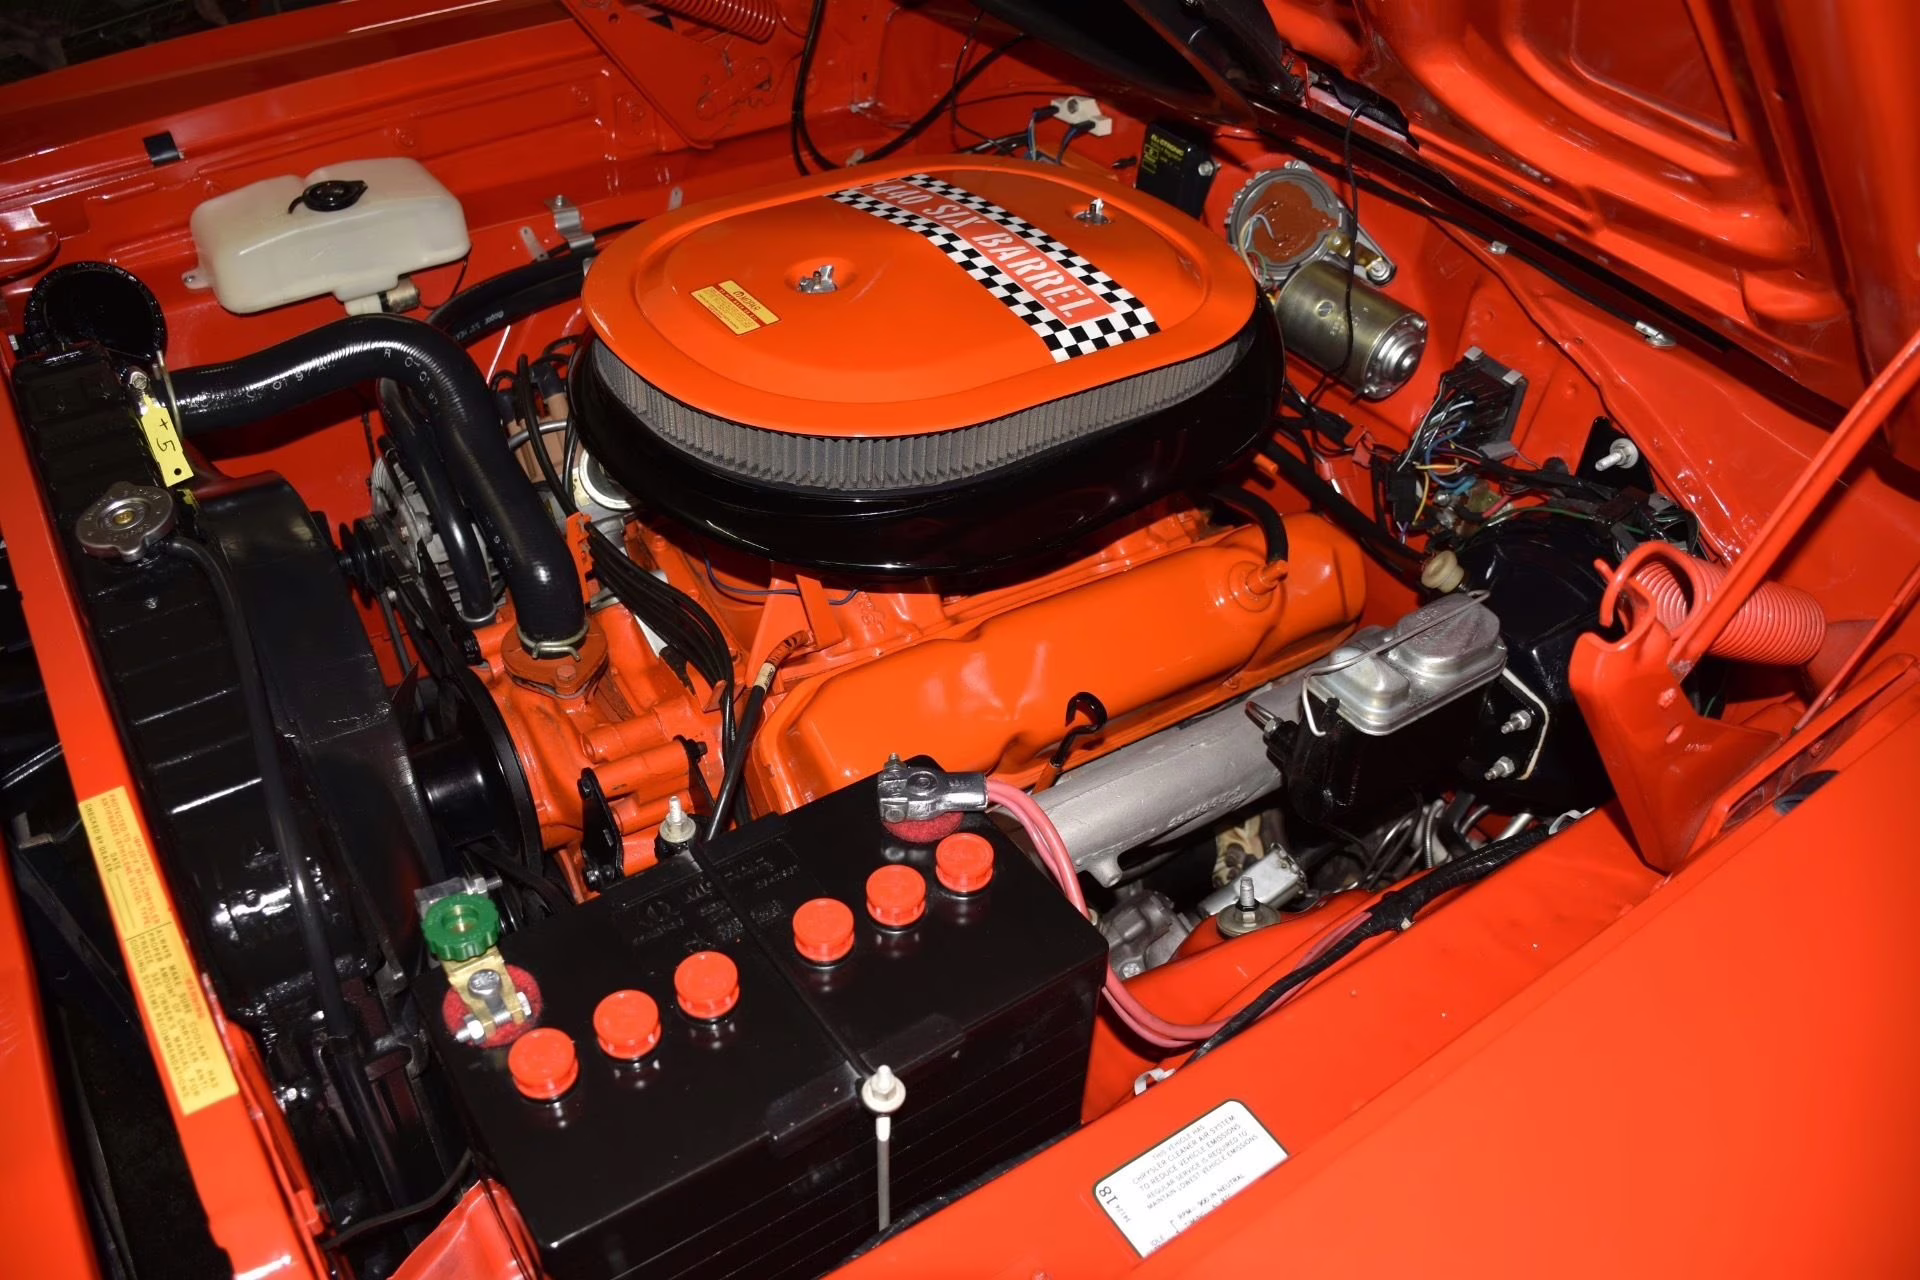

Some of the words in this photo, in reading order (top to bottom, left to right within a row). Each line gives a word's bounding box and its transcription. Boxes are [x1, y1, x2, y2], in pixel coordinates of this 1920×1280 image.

[871, 184, 934, 205] 440
[921, 203, 988, 229] SIX
[971, 233, 1096, 318] BARREL
[84, 803, 100, 834] CHECKED
[99, 846, 112, 872] DEALER
[109, 794, 127, 831] PROTECTED
[110, 852, 121, 869] DATE
[129, 939, 146, 973] COOLING
[147, 932, 163, 962] PROPER
[159, 966, 175, 998] AMOUNT
[171, 1002, 181, 1013] OF
[177, 1018, 198, 1063] CHRYSLER
[155, 928, 171, 958] ALWAYS
[169, 964, 182, 986] MAKE
[178, 992, 192, 1013] SURE
[189, 1021, 208, 1061] COOLANT
[206, 1069, 218, 1088] HAS
[185, 978, 205, 1019] WARNING
[151, 971, 161, 986] SEE
[173, 1035, 190, 1069] MANUAL
[188, 1077, 199, 1096] FOR
[1131, 1159, 1166, 1184] CHRYSLER
[1167, 1139, 1197, 1161] CLEANER
[1198, 1131, 1209, 1141] AIR
[1209, 1114, 1235, 1134] SYSTEM
[1139, 1182, 1150, 1191] TO
[1150, 1164, 1177, 1184] REDUCE
[1179, 1146, 1205, 1166] VEHICLE
[1206, 1123, 1240, 1148] EMISSIONS
[1146, 1178, 1175, 1199] REGULAR
[1175, 1162, 1200, 1181] SERVICE
[1207, 1136, 1238, 1159] REQUIRED
[1238, 1130, 1247, 1138] TO
[1146, 1187, 1176, 1209] MAINTAIN
[1176, 1171, 1201, 1190] LOWEST
[1201, 1155, 1226, 1174] VEHICLE
[1226, 1133, 1258, 1157] EMISSIONS
[1152, 1148, 1166, 1160] THIS
[1167, 1132, 1191, 1150] VEHICLE
[1191, 1123, 1205, 1134] HAS
[1216, 1171, 1245, 1193] NEUTRAL
